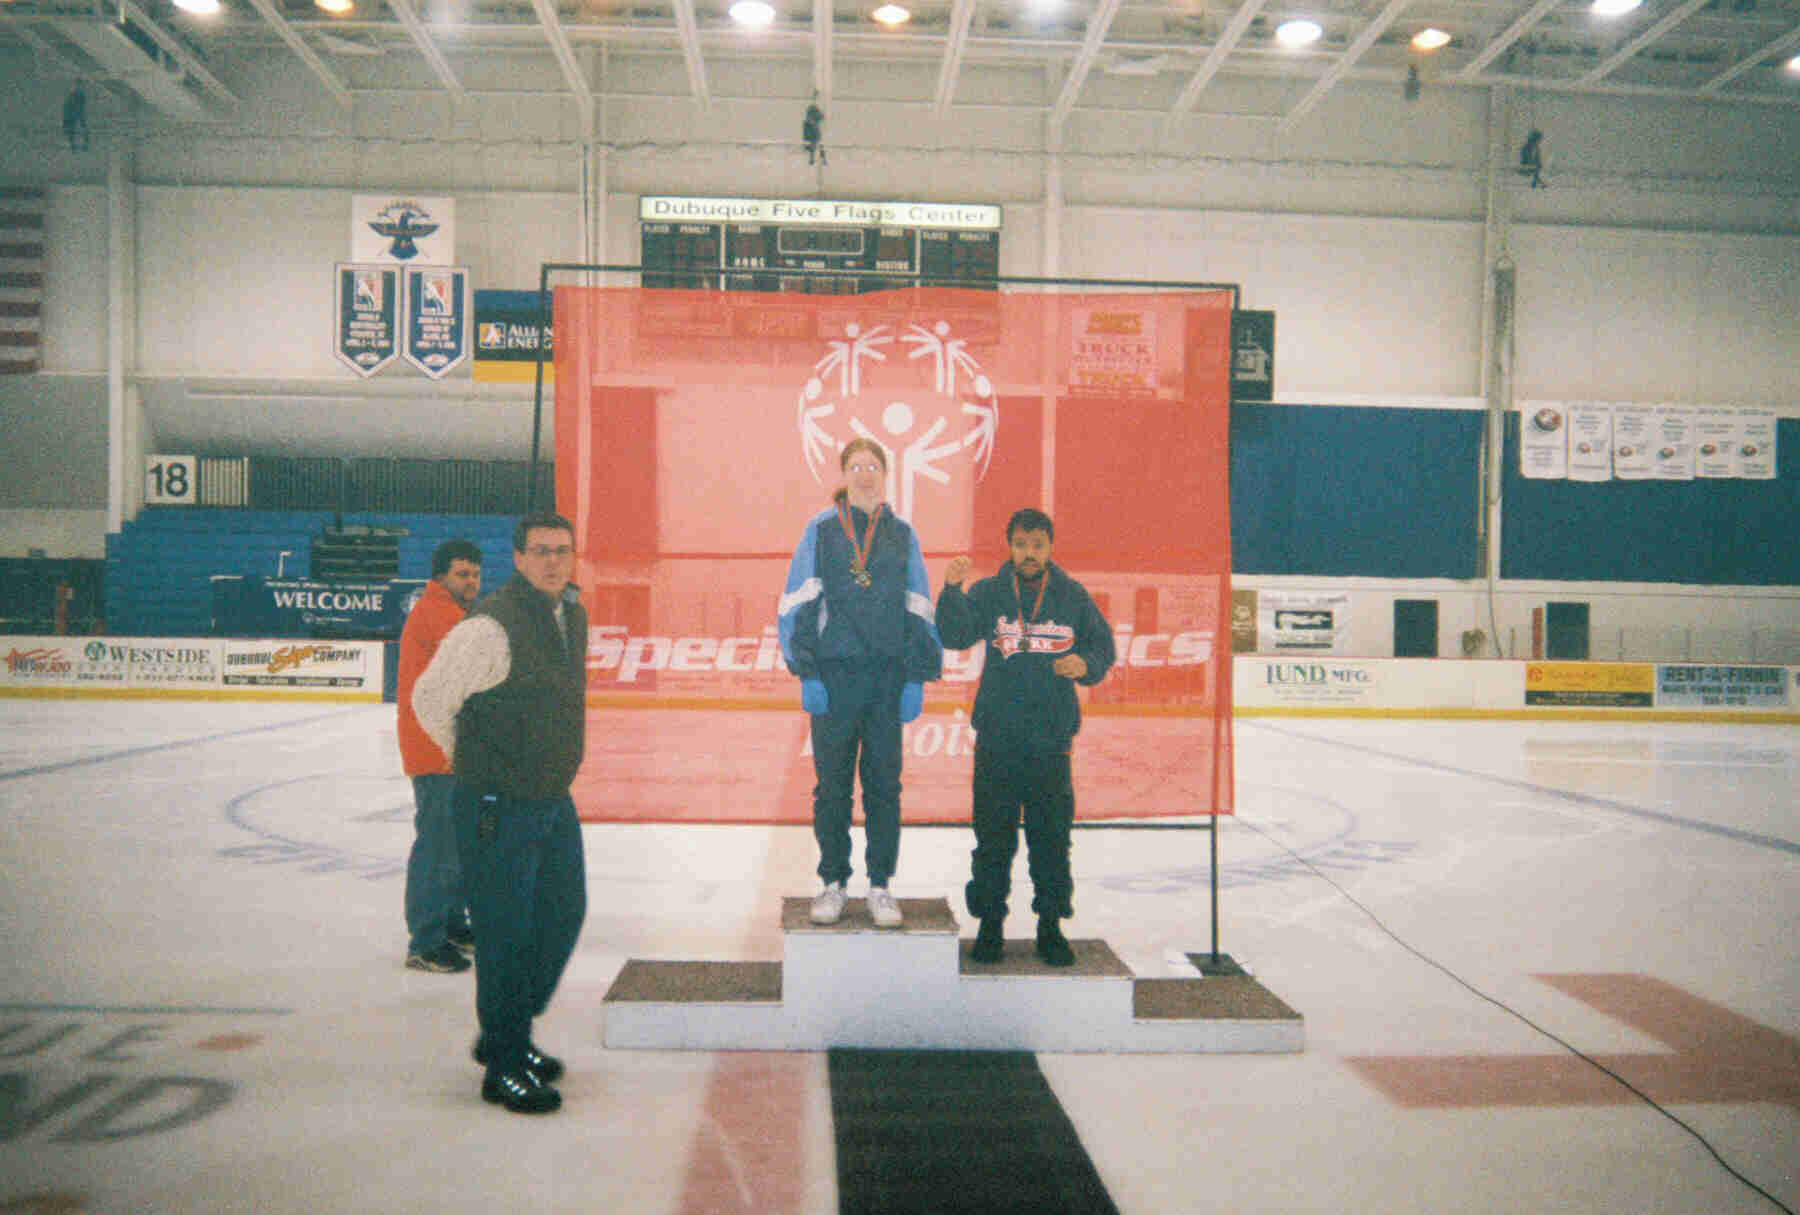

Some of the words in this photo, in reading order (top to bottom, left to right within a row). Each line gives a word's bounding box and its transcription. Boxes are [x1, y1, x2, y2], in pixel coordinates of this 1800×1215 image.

[655, 200, 760, 217] Dubuque
[773, 203, 820, 217] Five
[833, 205, 896, 221] Flags
[909, 206, 987, 222] Center
[149, 462, 189, 497] 18
[273, 591, 384, 612] WELCOME
[110, 645, 210, 664] WESTSIDE
[585, 624, 790, 682] Speci
